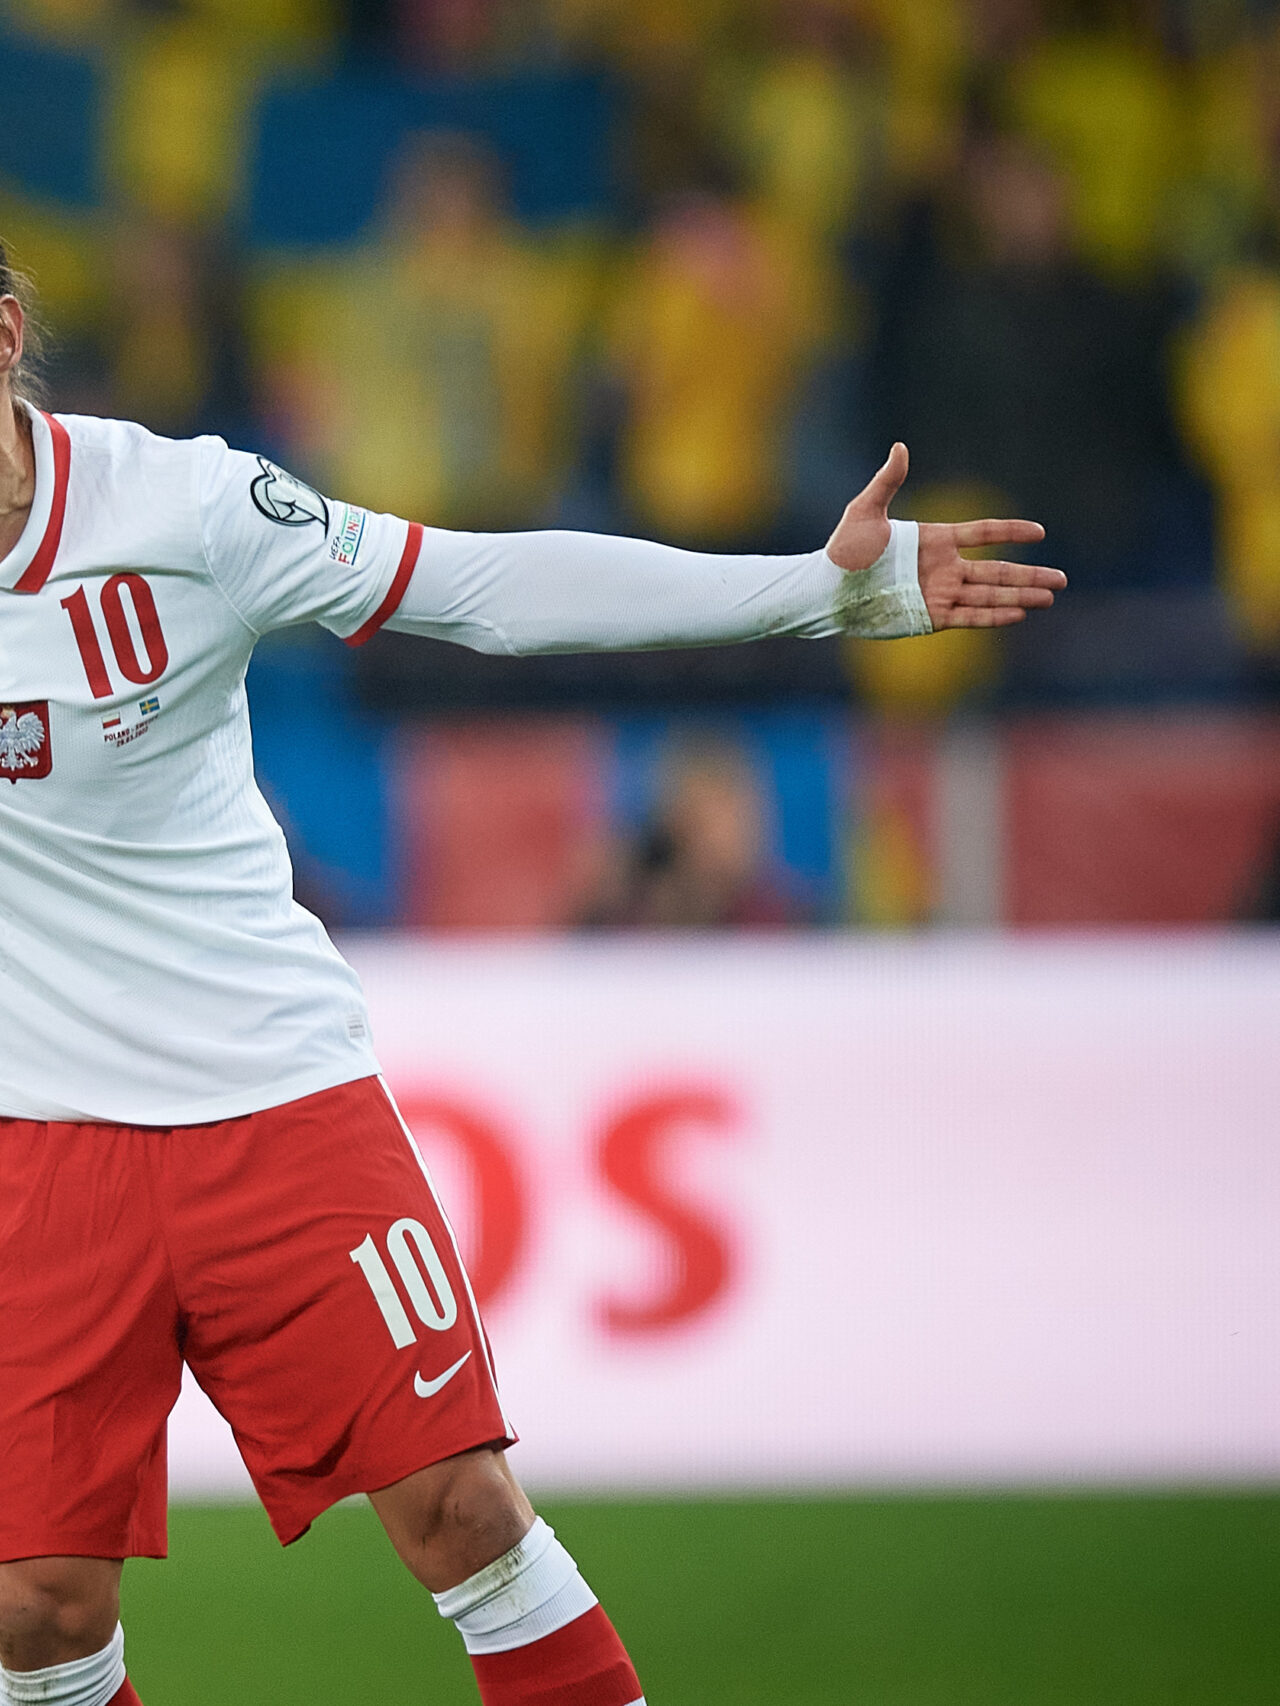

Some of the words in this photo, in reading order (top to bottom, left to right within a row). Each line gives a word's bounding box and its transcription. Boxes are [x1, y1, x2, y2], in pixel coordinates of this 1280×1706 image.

[329, 535, 342, 560] UEFA
[338, 505, 362, 565] FOUND
[60, 571, 169, 700] 10
[104, 727, 130, 743] POLAND
[349, 1217, 458, 1350] 10
